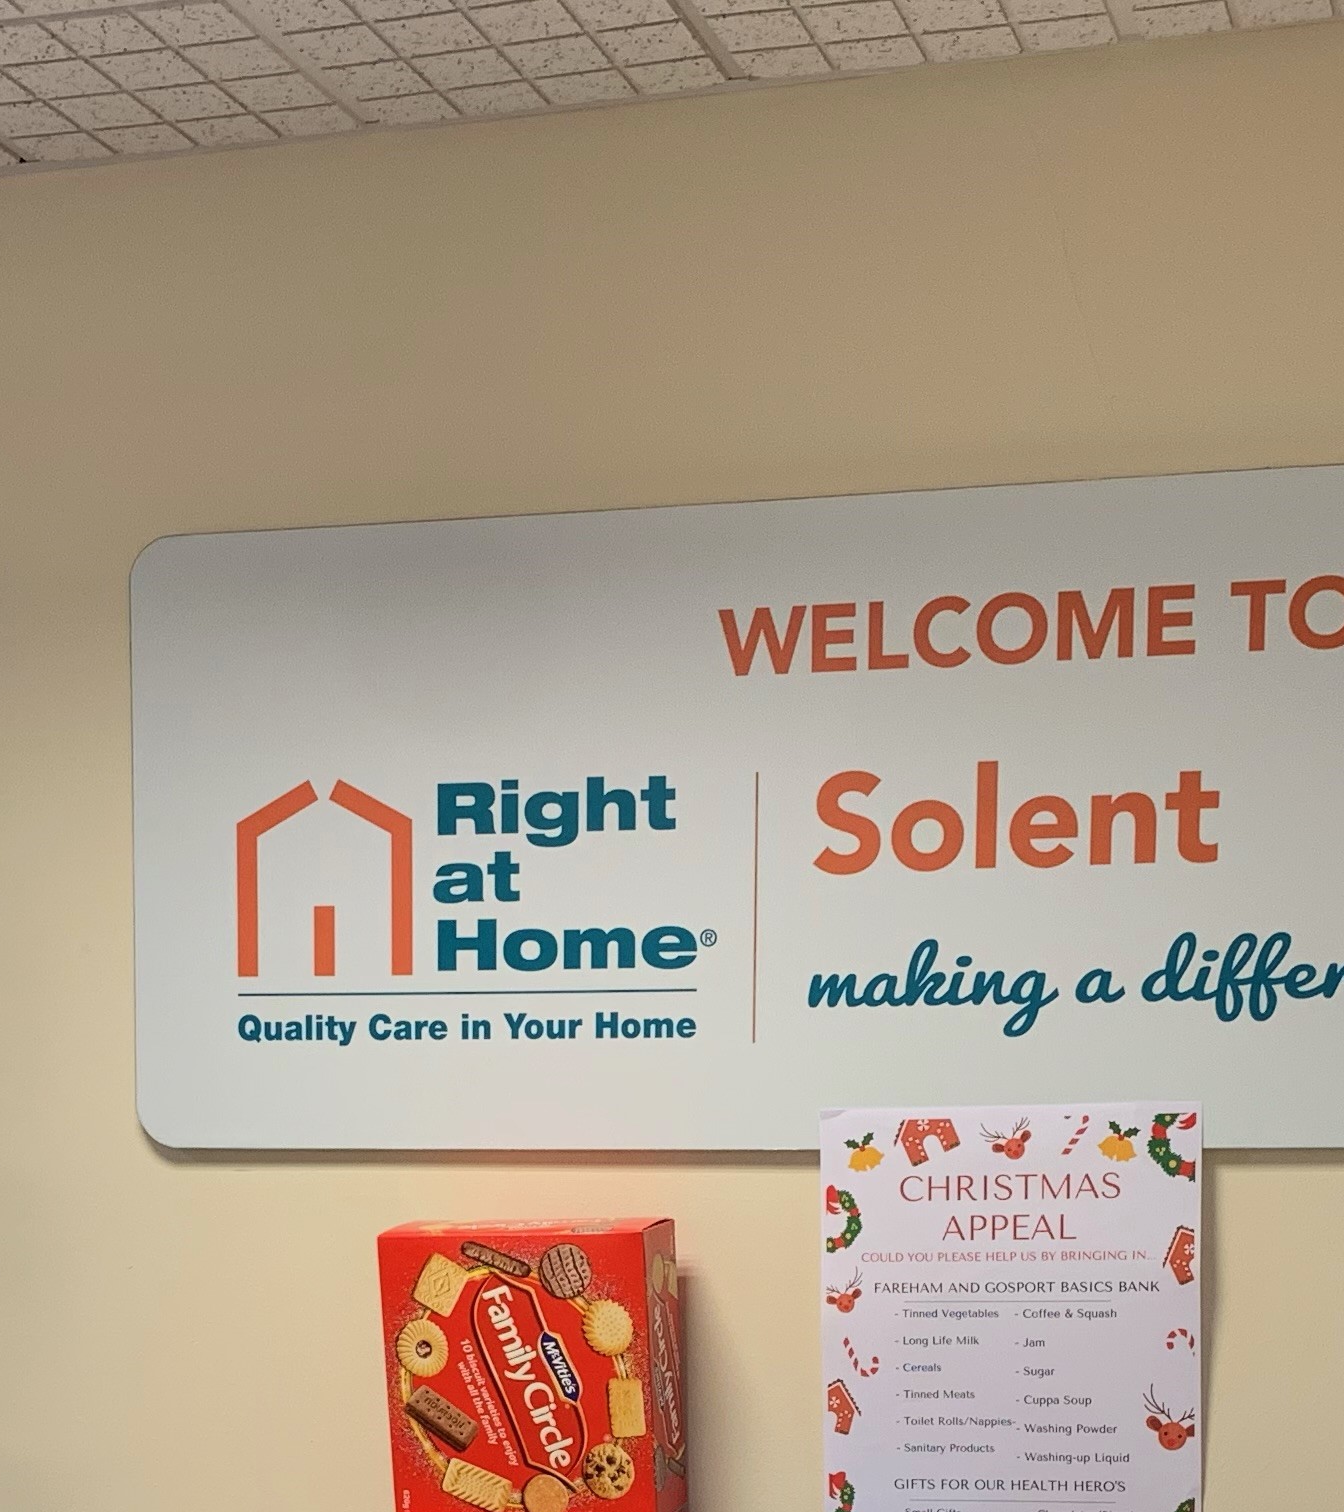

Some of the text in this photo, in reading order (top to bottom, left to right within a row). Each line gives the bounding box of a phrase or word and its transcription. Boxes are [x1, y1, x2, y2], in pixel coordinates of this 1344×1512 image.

[719, 583, 1197, 676] WELCOME
[436, 776, 676, 848] Right
[812, 763, 1221, 877] Solent
[433, 851, 520, 903] at
[807, 943, 1061, 1039] making
[1080, 965, 1126, 1006] a
[238, 1009, 697, 1047] Quality Care in Your Home
[900, 1172, 1121, 1201] CHRISTMAS
[943, 1214, 1076, 1240] APPEAL
[862, 1252, 904, 1263] COULD
[907, 1252, 933, 1263] YOU
[938, 1251, 982, 1262] PLEASE
[986, 1251, 1016, 1262] HELP
[1021, 1251, 1036, 1261] US
[1041, 1251, 1056, 1261] BY
[1061, 1250, 1127, 1261] BRINGING
[874, 1281, 1159, 1293] FAREHAM AND GOSPORT BASICS BANK
[903, 1309, 999, 1320] Tinned Vegetables
[1023, 1309, 1117, 1320] Coffee & Squash
[903, 1336, 979, 1347] Long Life Milk
[1023, 1338, 1045, 1348] Jam
[542, 1341, 576, 1395] McVitie's
[903, 1363, 941, 1372] Cereals
[1023, 1367, 1055, 1378] Sugar
[482, 1284, 574, 1469] Family Circle
[904, 1389, 975, 1399] Tinned Meats
[458, 1361, 498, 1445] with all the family
[460, 1339, 518, 1466] 10 biscuit varieties to enjoy
[1024, 1396, 1091, 1407] Cuppa Soup
[904, 1416, 934, 1426] Toilet
[1024, 1424, 1117, 1436] Washing Powder
[904, 1443, 995, 1454] Sanitary Products
[1025, 1452, 1130, 1464] Washing-up Liquid
[894, 1479, 1126, 1492] GIFTS FOR OUR HEALTH HERO'S
